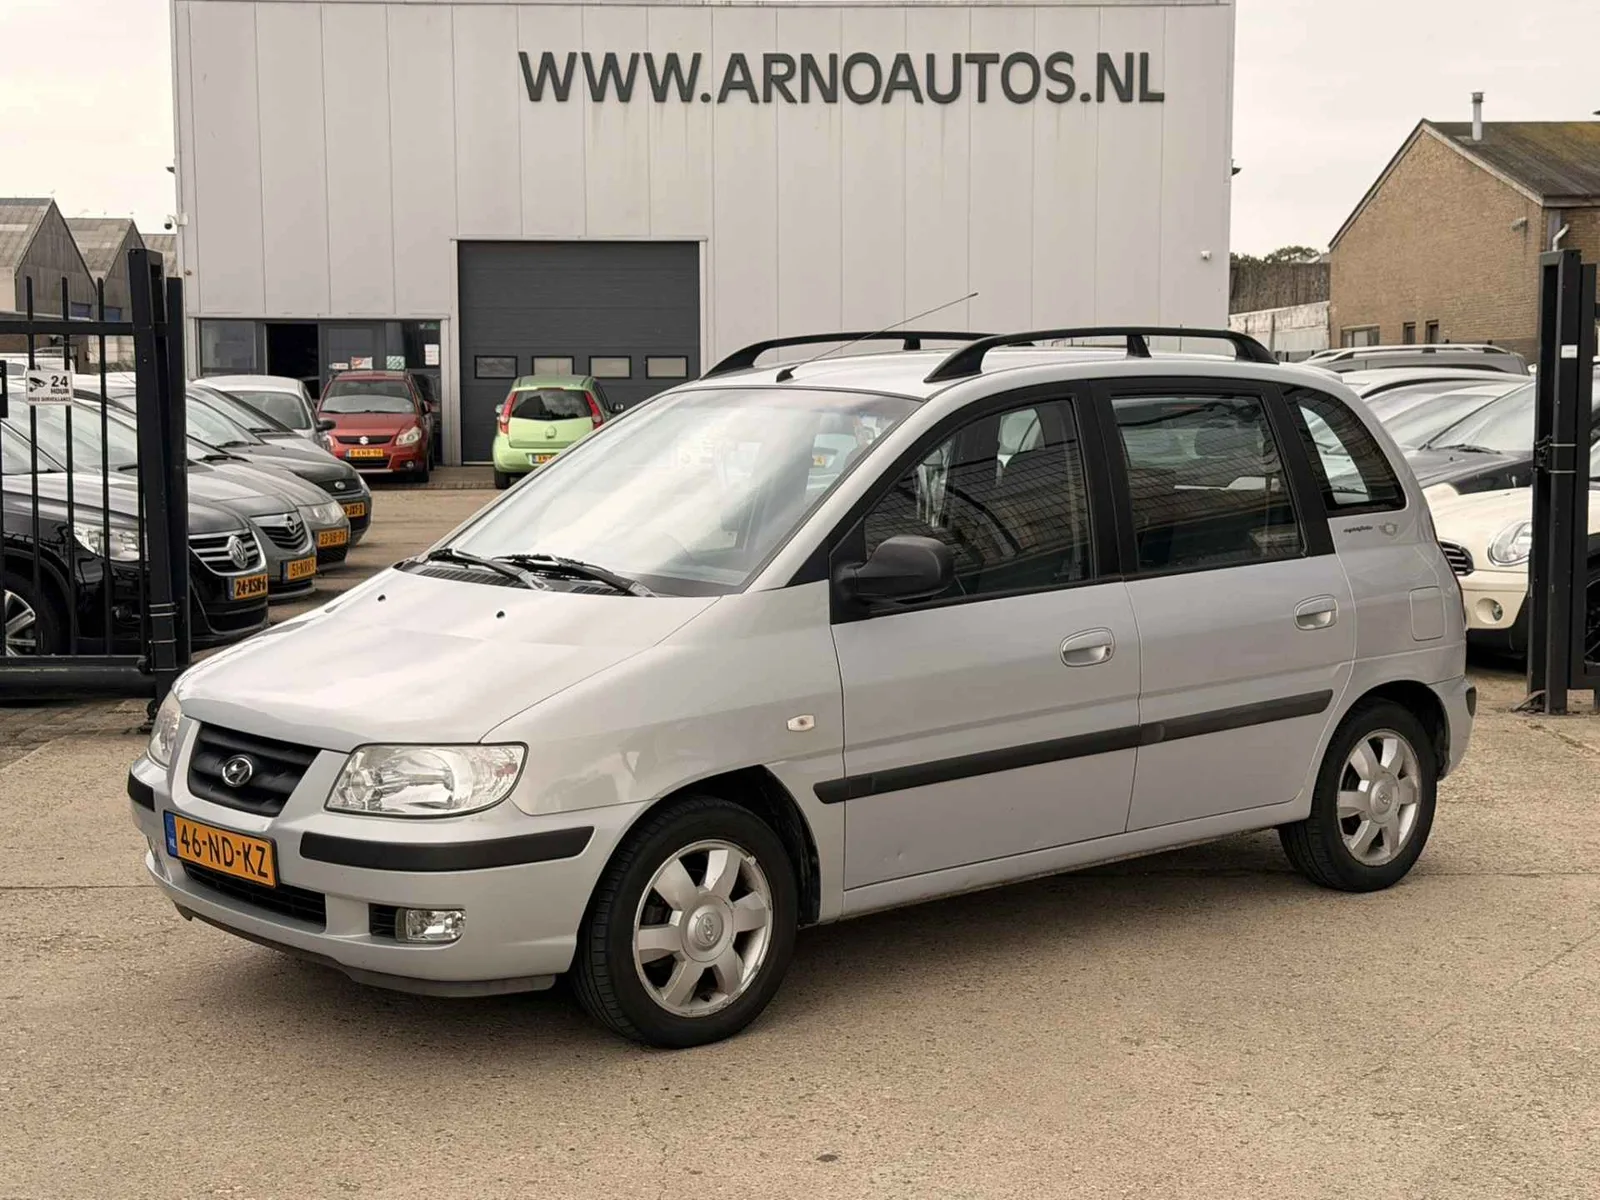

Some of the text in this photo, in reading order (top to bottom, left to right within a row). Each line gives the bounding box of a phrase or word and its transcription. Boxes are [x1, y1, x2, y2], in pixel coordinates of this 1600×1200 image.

[518, 51, 1165, 104] WWW.ARNOAUTOS.NL
[51, 375, 69, 387] 24
[180, 823, 269, 879] 46-ND-KZ
